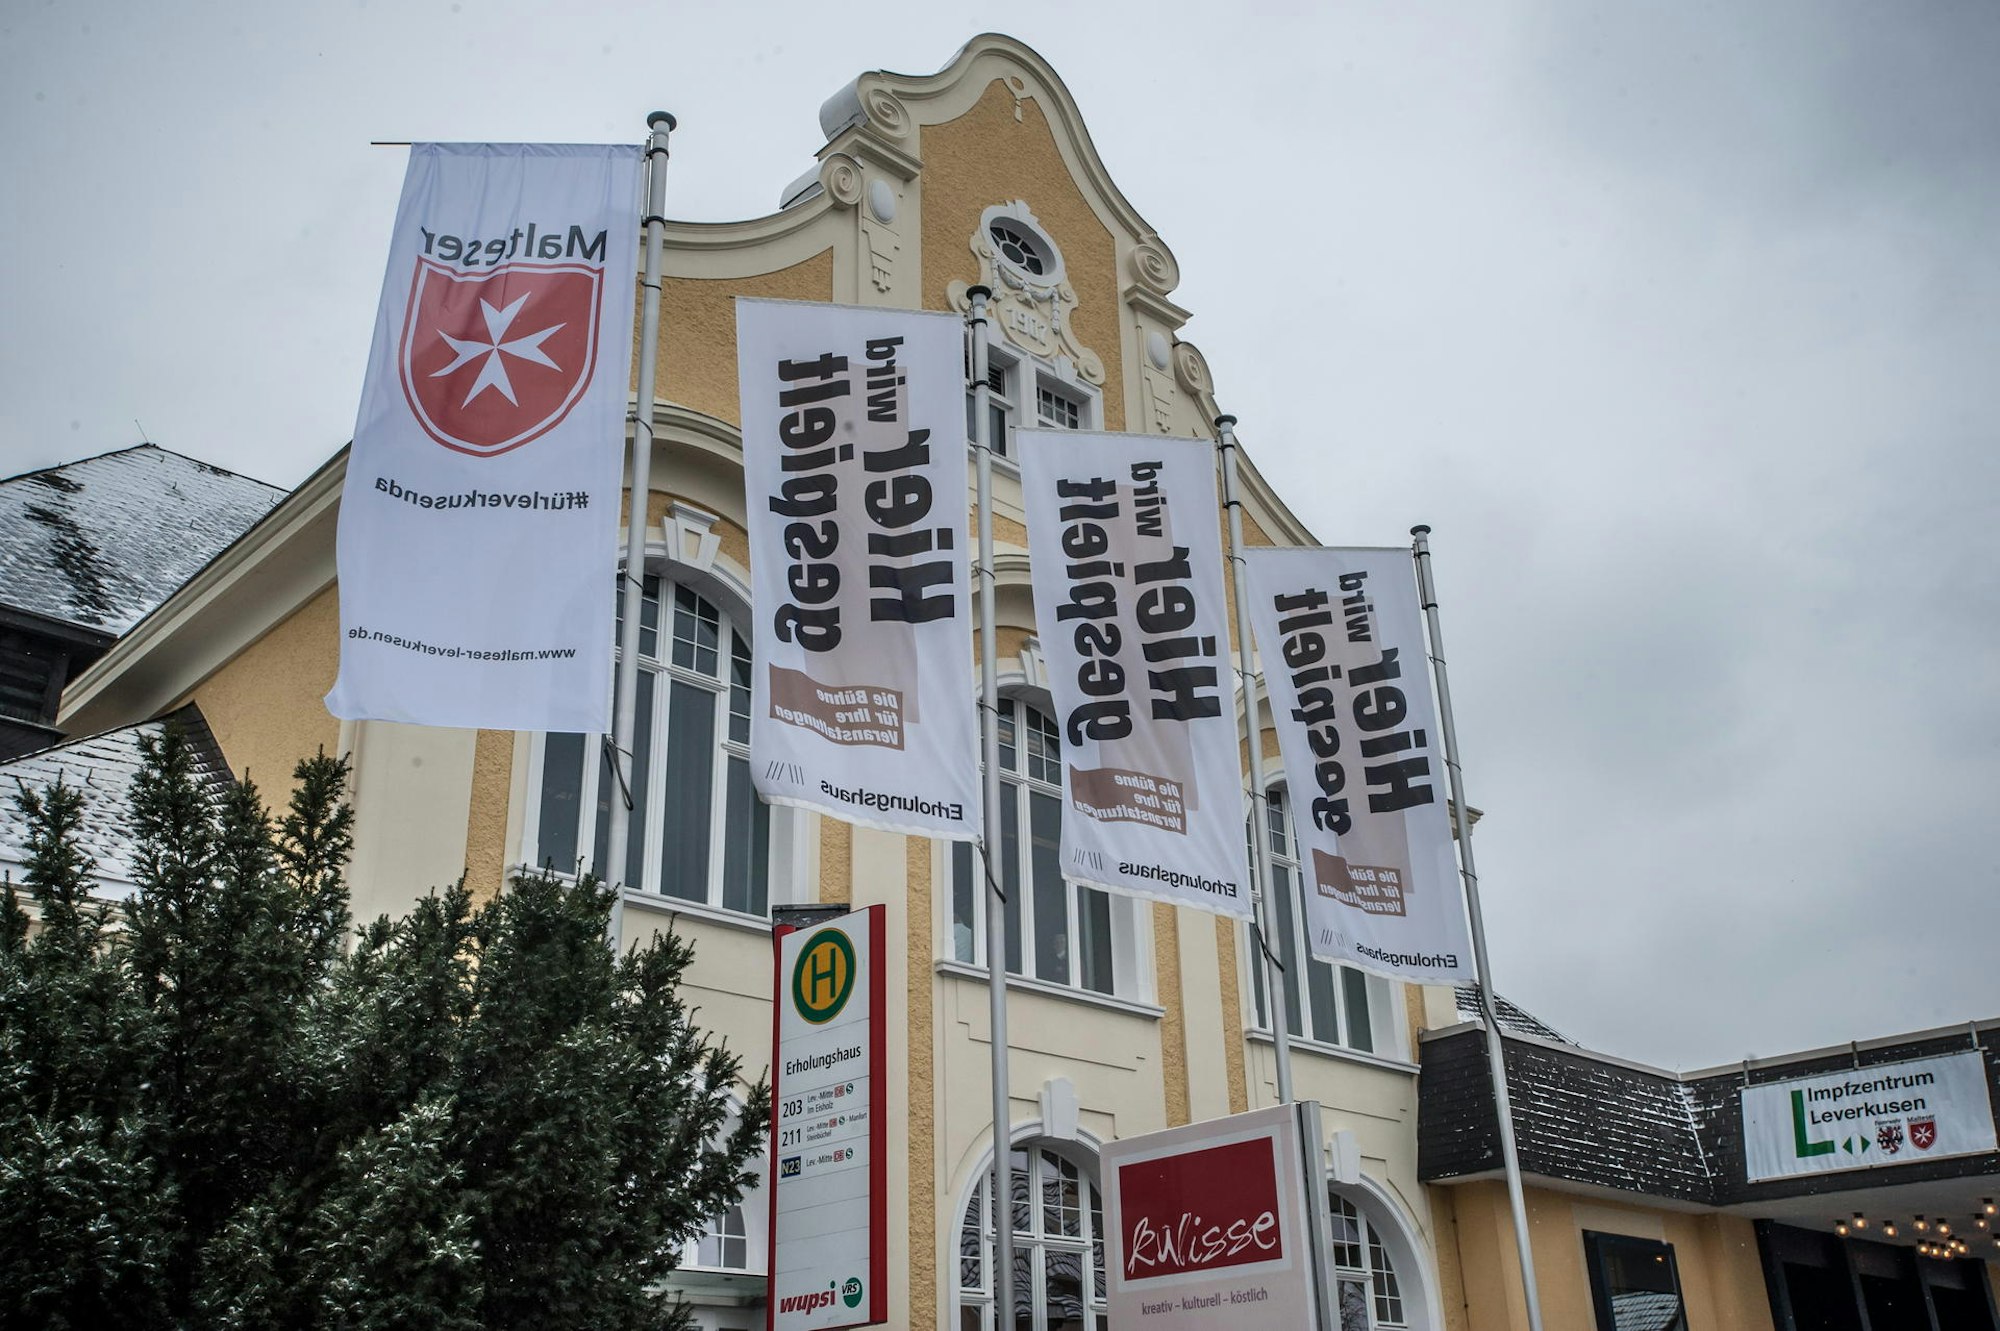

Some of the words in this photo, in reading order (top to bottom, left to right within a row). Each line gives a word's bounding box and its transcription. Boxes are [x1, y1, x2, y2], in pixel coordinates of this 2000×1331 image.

[811, 947, 836, 1004] H
[786, 1046, 861, 1076] Erholungshaus
[1807, 1071, 1934, 1102] Impfzentrum
[783, 1099, 803, 1118] 203
[1810, 1098, 1926, 1125] Leverkusen
[782, 1128, 801, 1147] 211
[781, 1160, 801, 1175] N23
[780, 1280, 836, 1315] wupsi
[842, 1283, 858, 1294] VRS
[1142, 1301, 1173, 1315] kreativ
[1182, 1293, 1221, 1311] kulturell
[1230, 1287, 1268, 1305] köstlich
